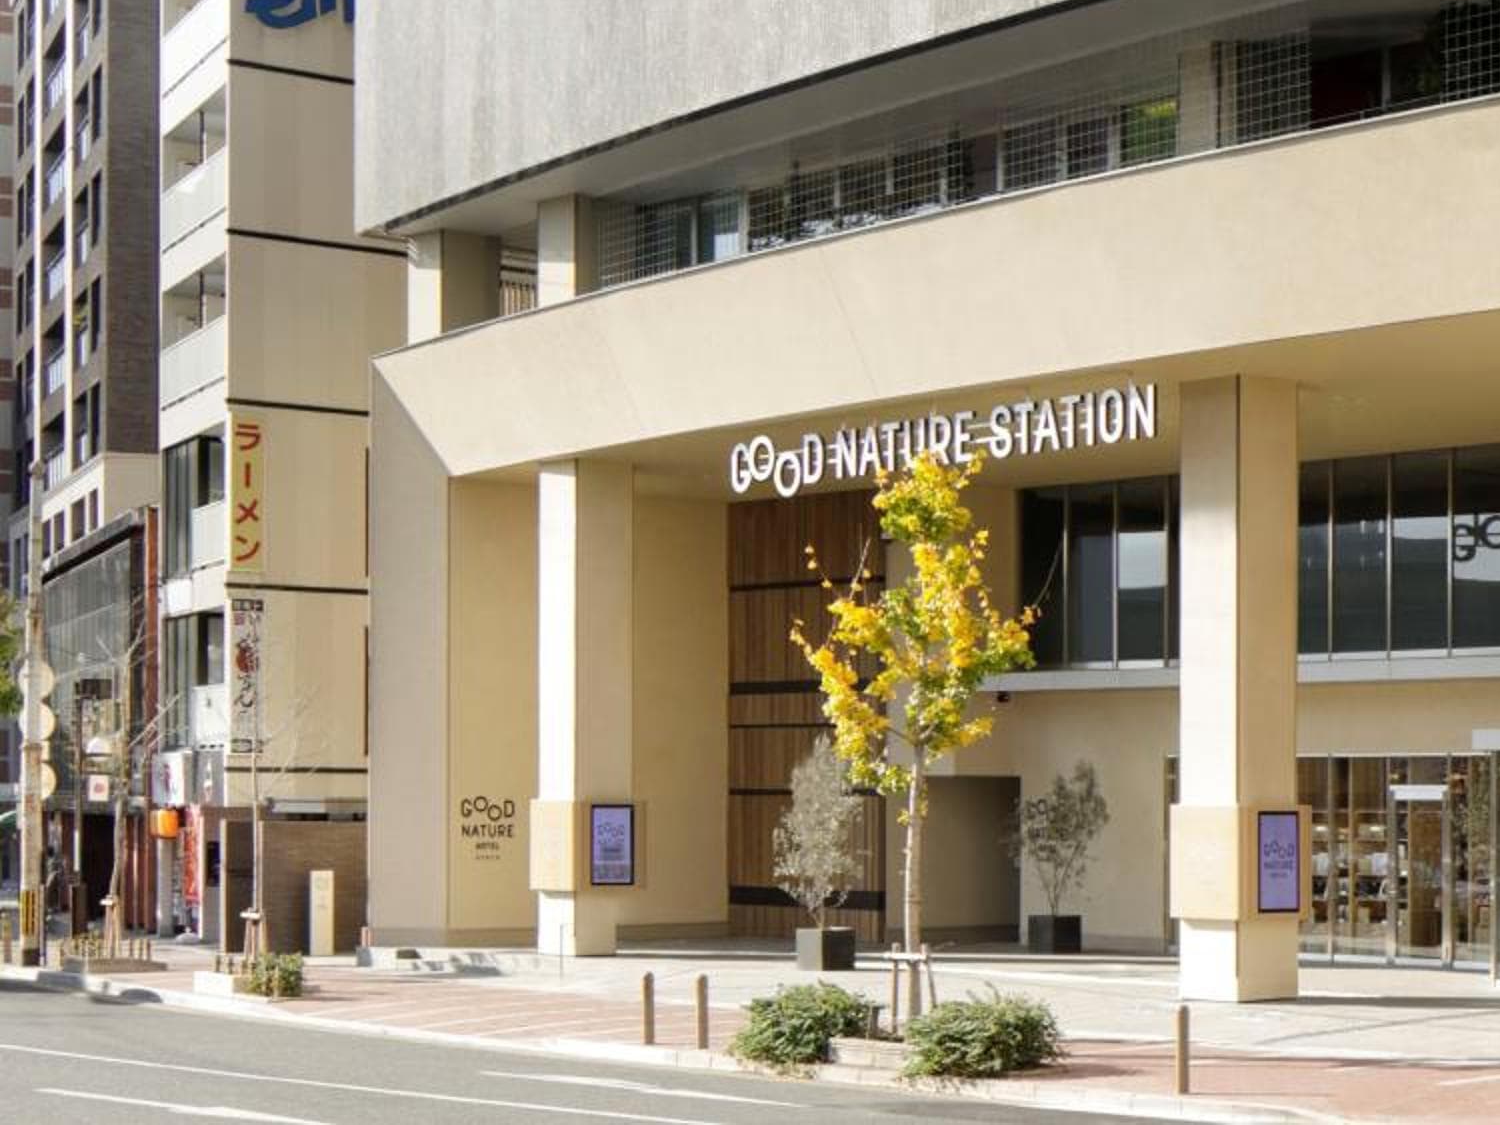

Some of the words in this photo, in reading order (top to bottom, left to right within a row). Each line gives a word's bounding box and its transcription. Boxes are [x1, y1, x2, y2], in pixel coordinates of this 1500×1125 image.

[730, 435, 825, 499] GOOD
[836, 410, 976, 479] NATURE
[989, 383, 1157, 459] STATION
[234, 422, 261, 563] ラーメン
[460, 795, 515, 822] GOOD
[461, 824, 514, 838] NATURE
